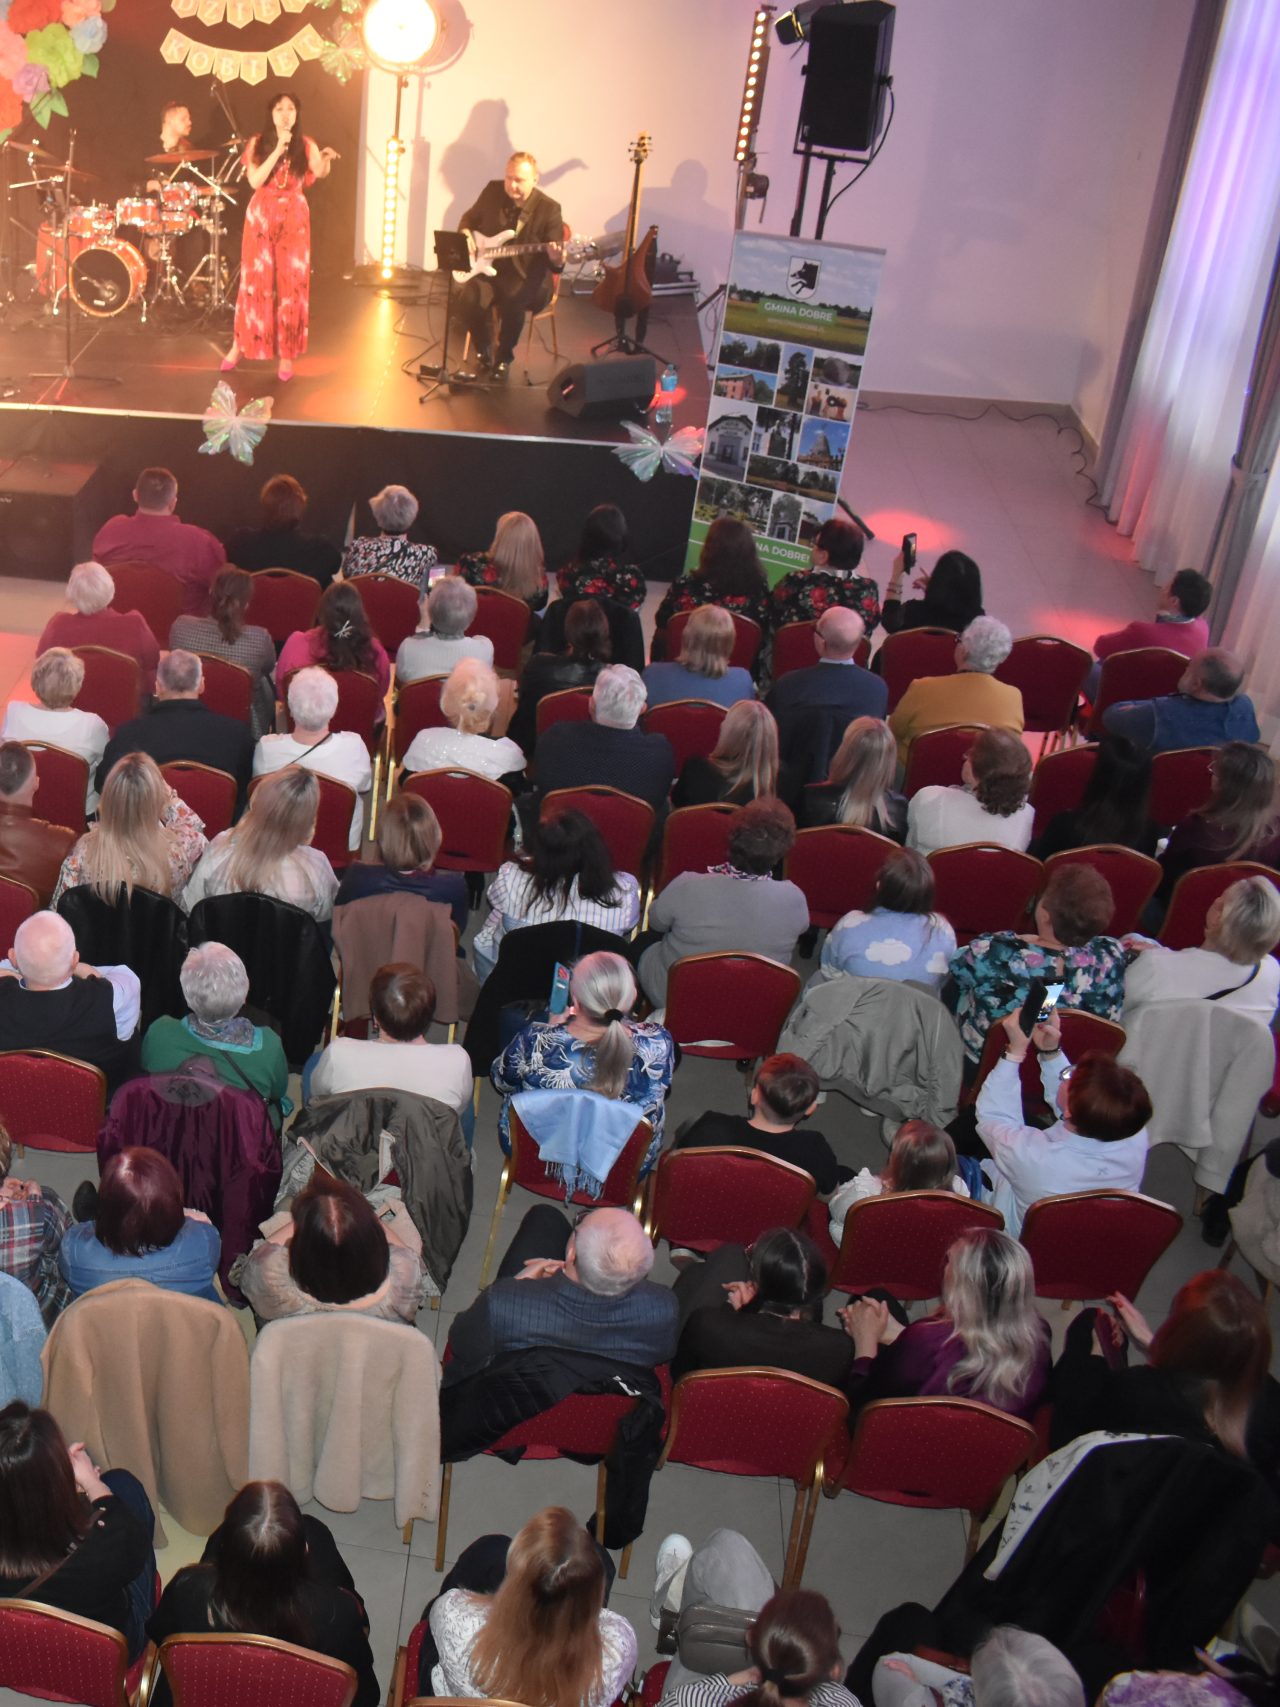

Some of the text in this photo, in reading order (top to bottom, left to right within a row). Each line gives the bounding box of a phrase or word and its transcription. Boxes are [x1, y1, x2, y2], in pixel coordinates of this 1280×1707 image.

[177, 0, 306, 21] DZIE
[168, 35, 320, 80] KOBIET
[764, 302, 833, 322] GMINA DOBRE
[772, 546, 810, 563] DOBRE!
